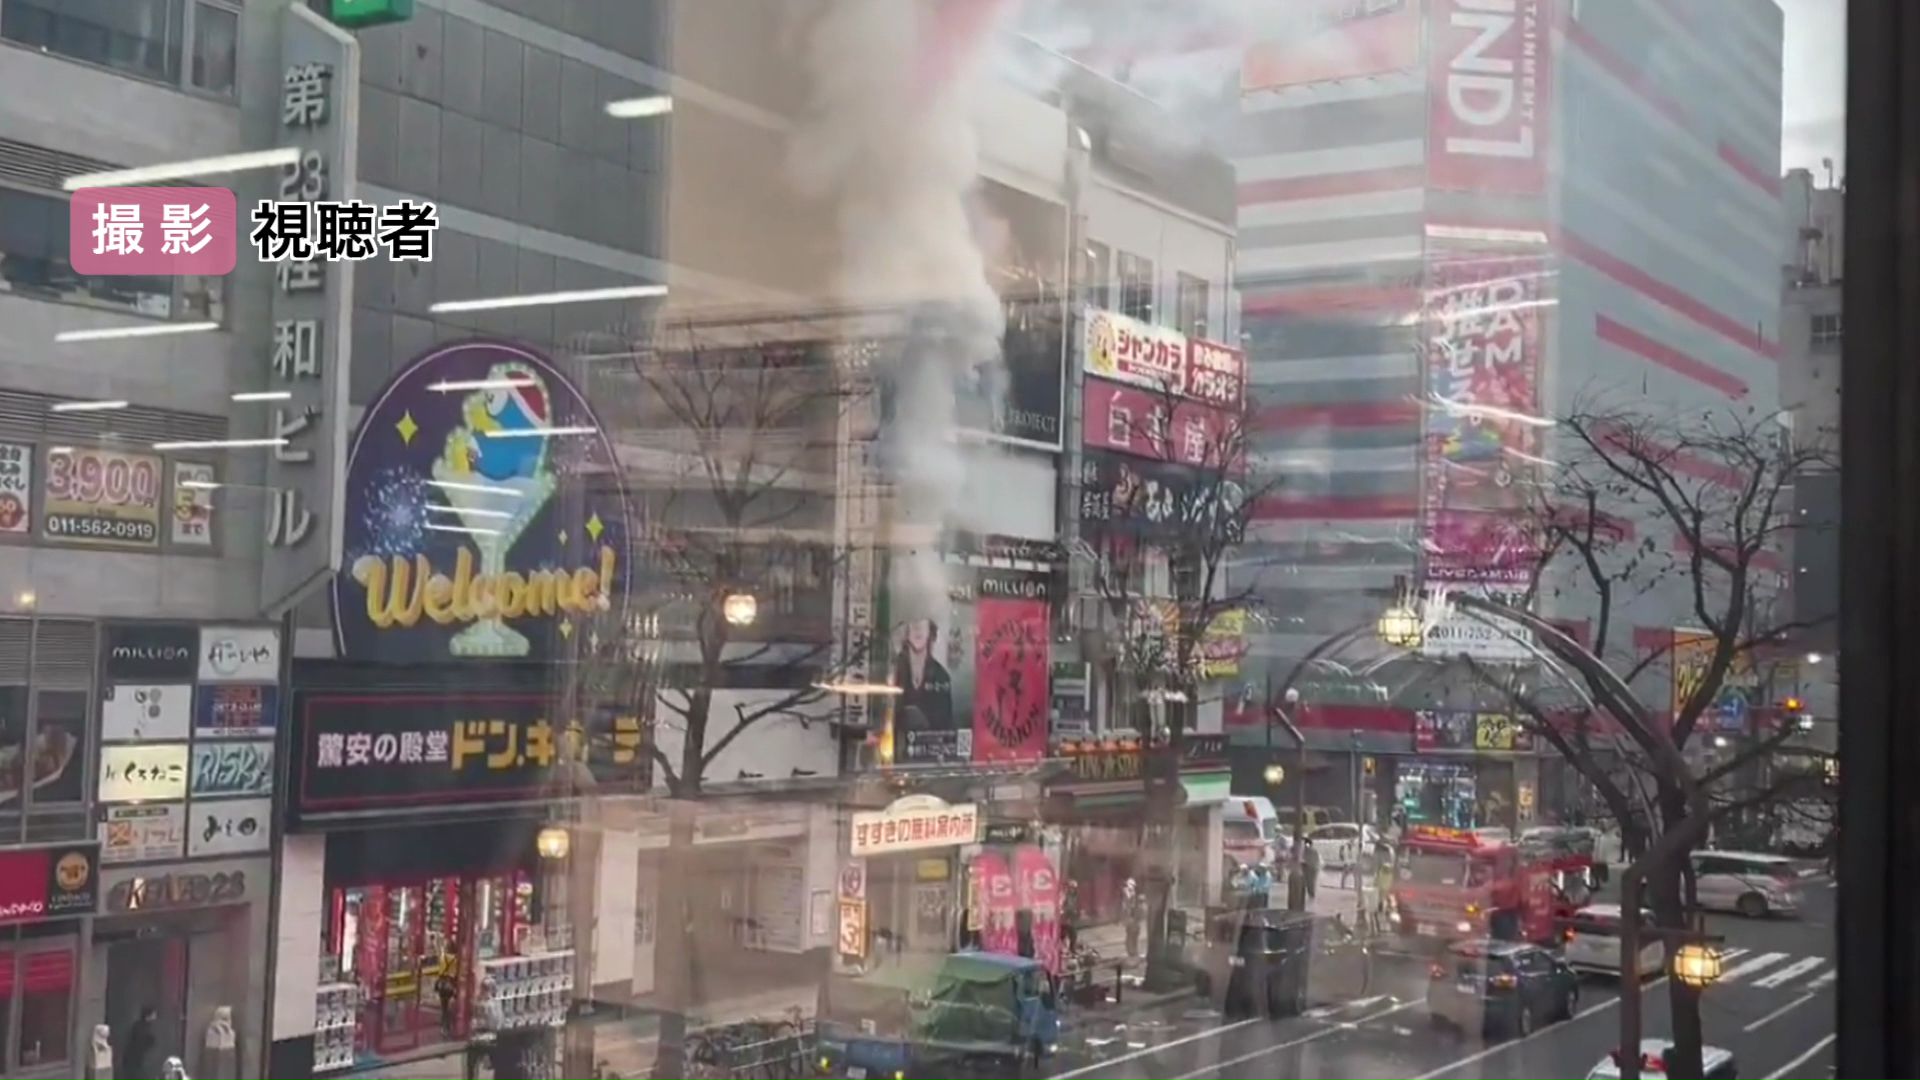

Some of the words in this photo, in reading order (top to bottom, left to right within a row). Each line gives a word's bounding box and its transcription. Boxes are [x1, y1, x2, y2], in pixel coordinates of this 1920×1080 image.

[1446, 0, 1534, 158] ND1
[1118, 329, 1182, 369] ジャンカラ
[48, 516, 154, 538] 011-562-0919
[352, 545, 616, 629] Welcome!
[318, 731, 448, 767] 驚安の殿堂
[856, 812, 974, 846] すすきの無料案内所
